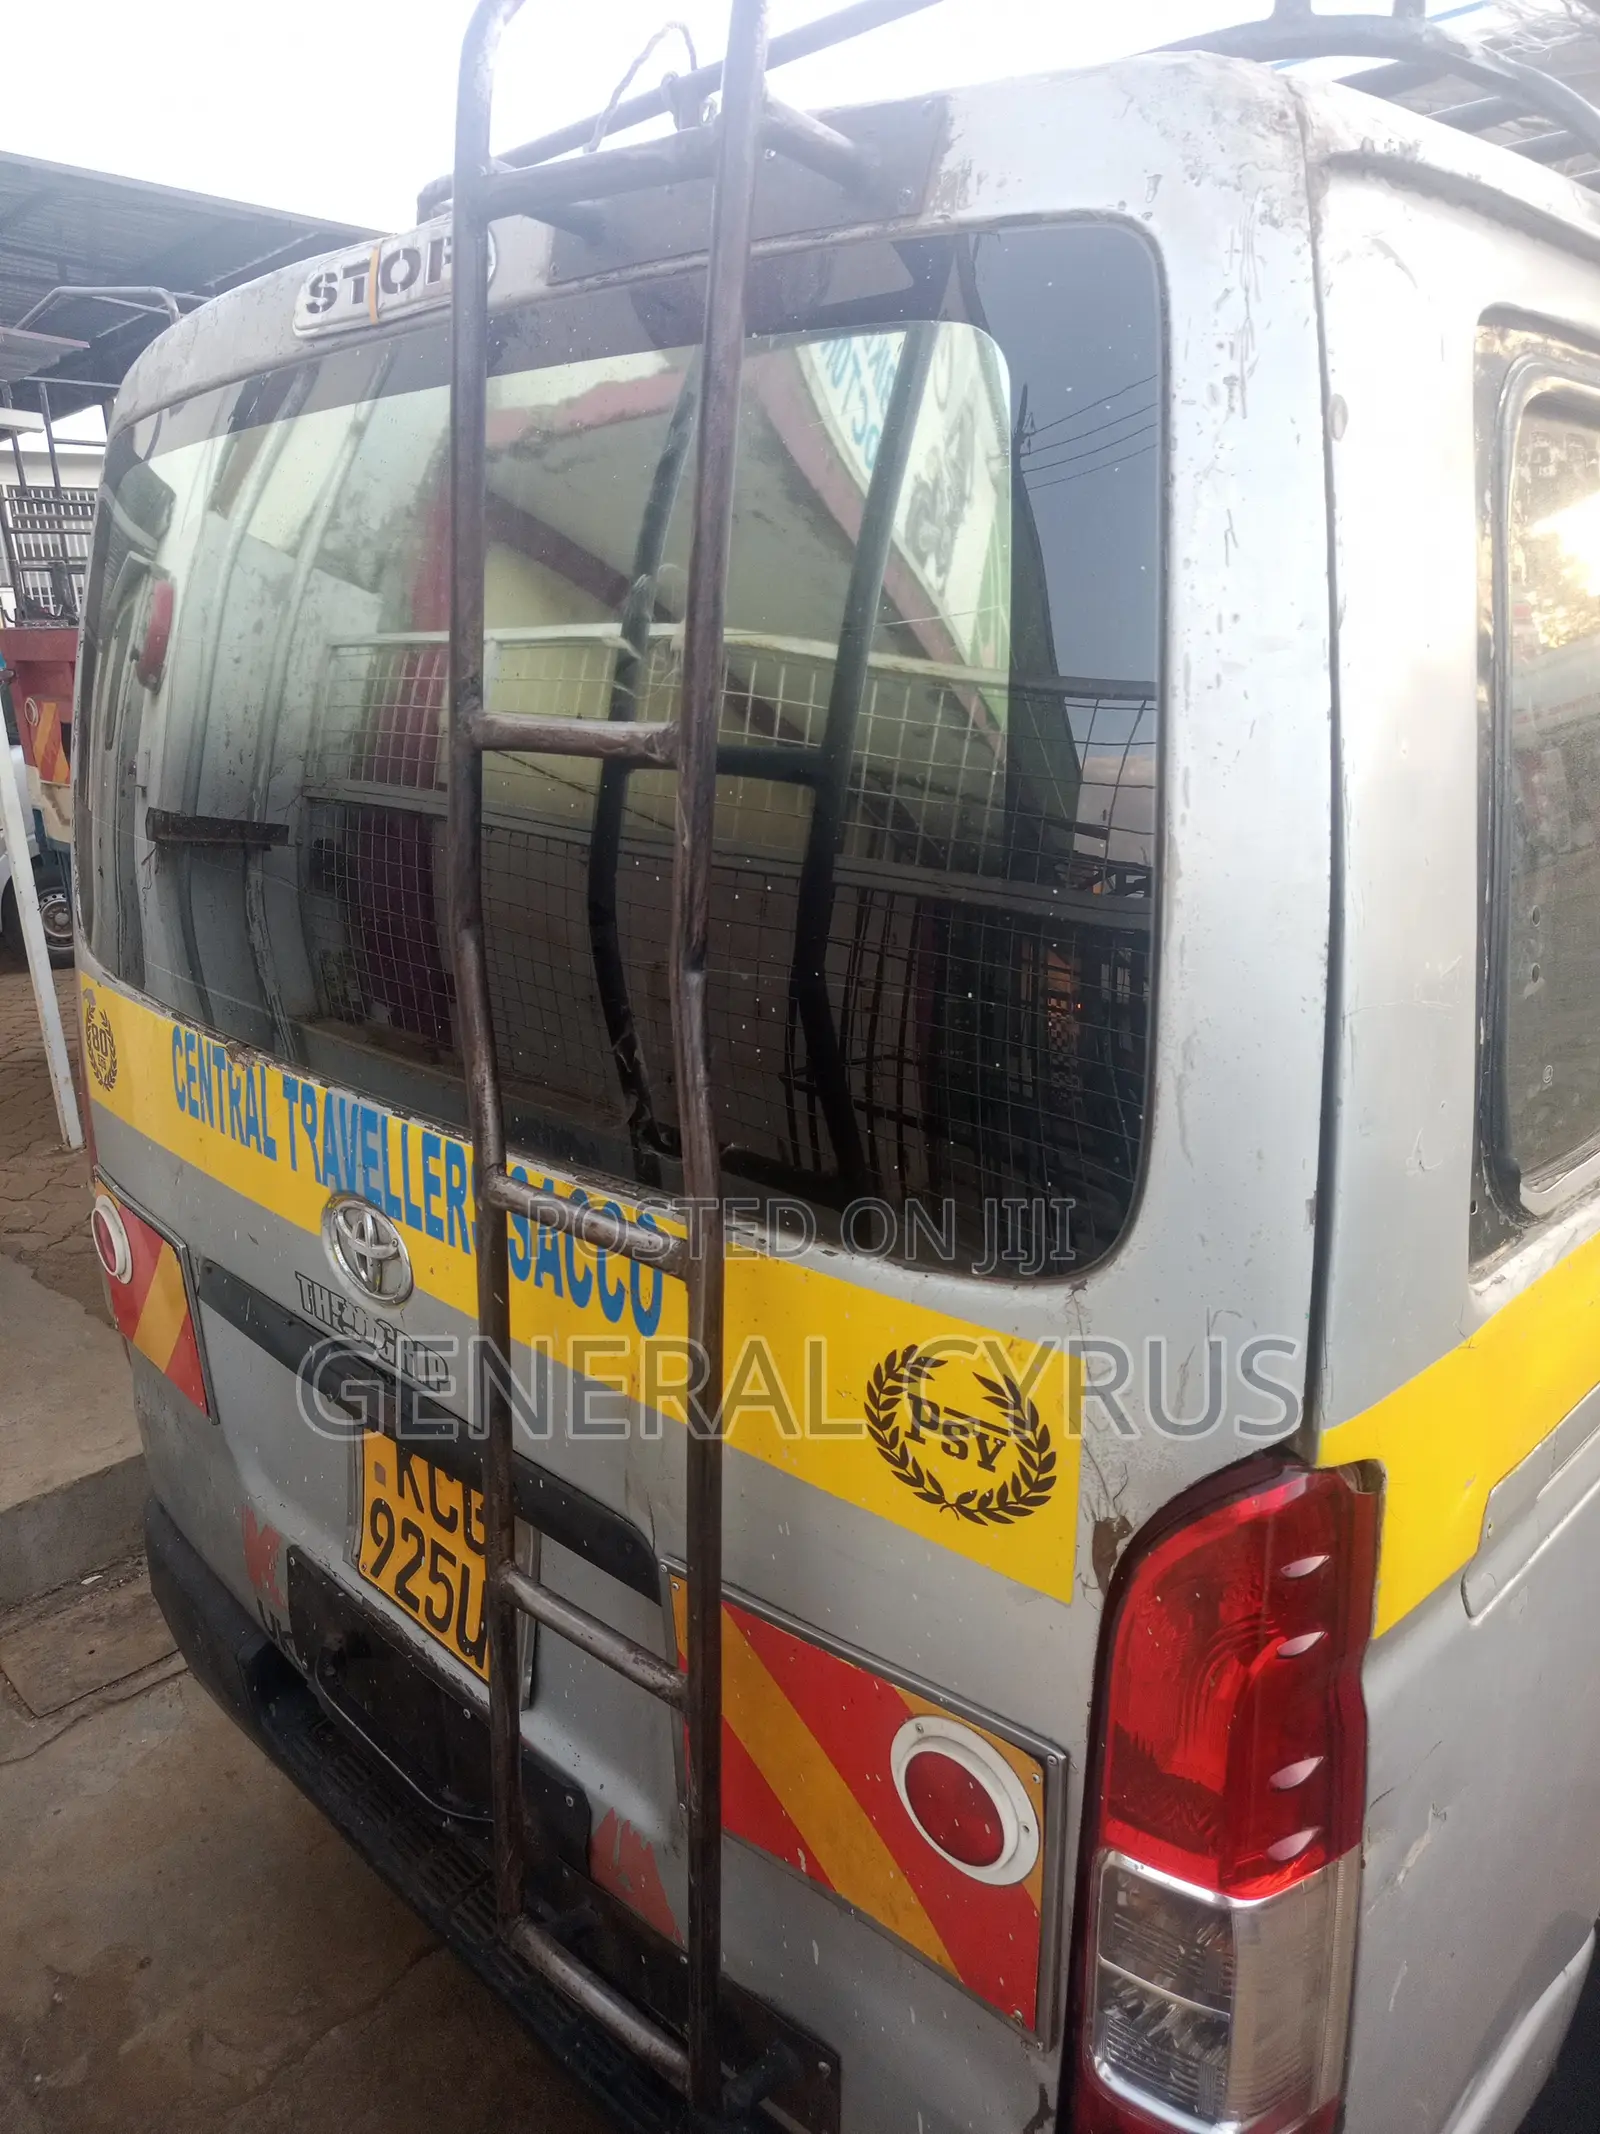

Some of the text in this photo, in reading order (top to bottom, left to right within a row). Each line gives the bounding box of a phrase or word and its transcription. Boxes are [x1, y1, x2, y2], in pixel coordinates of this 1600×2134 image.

[91, 1023, 108, 1057] 80
[171, 1024, 664, 1339] CENTRAL TRAVELLER SACCO
[904, 1392, 1007, 1473] PSV
